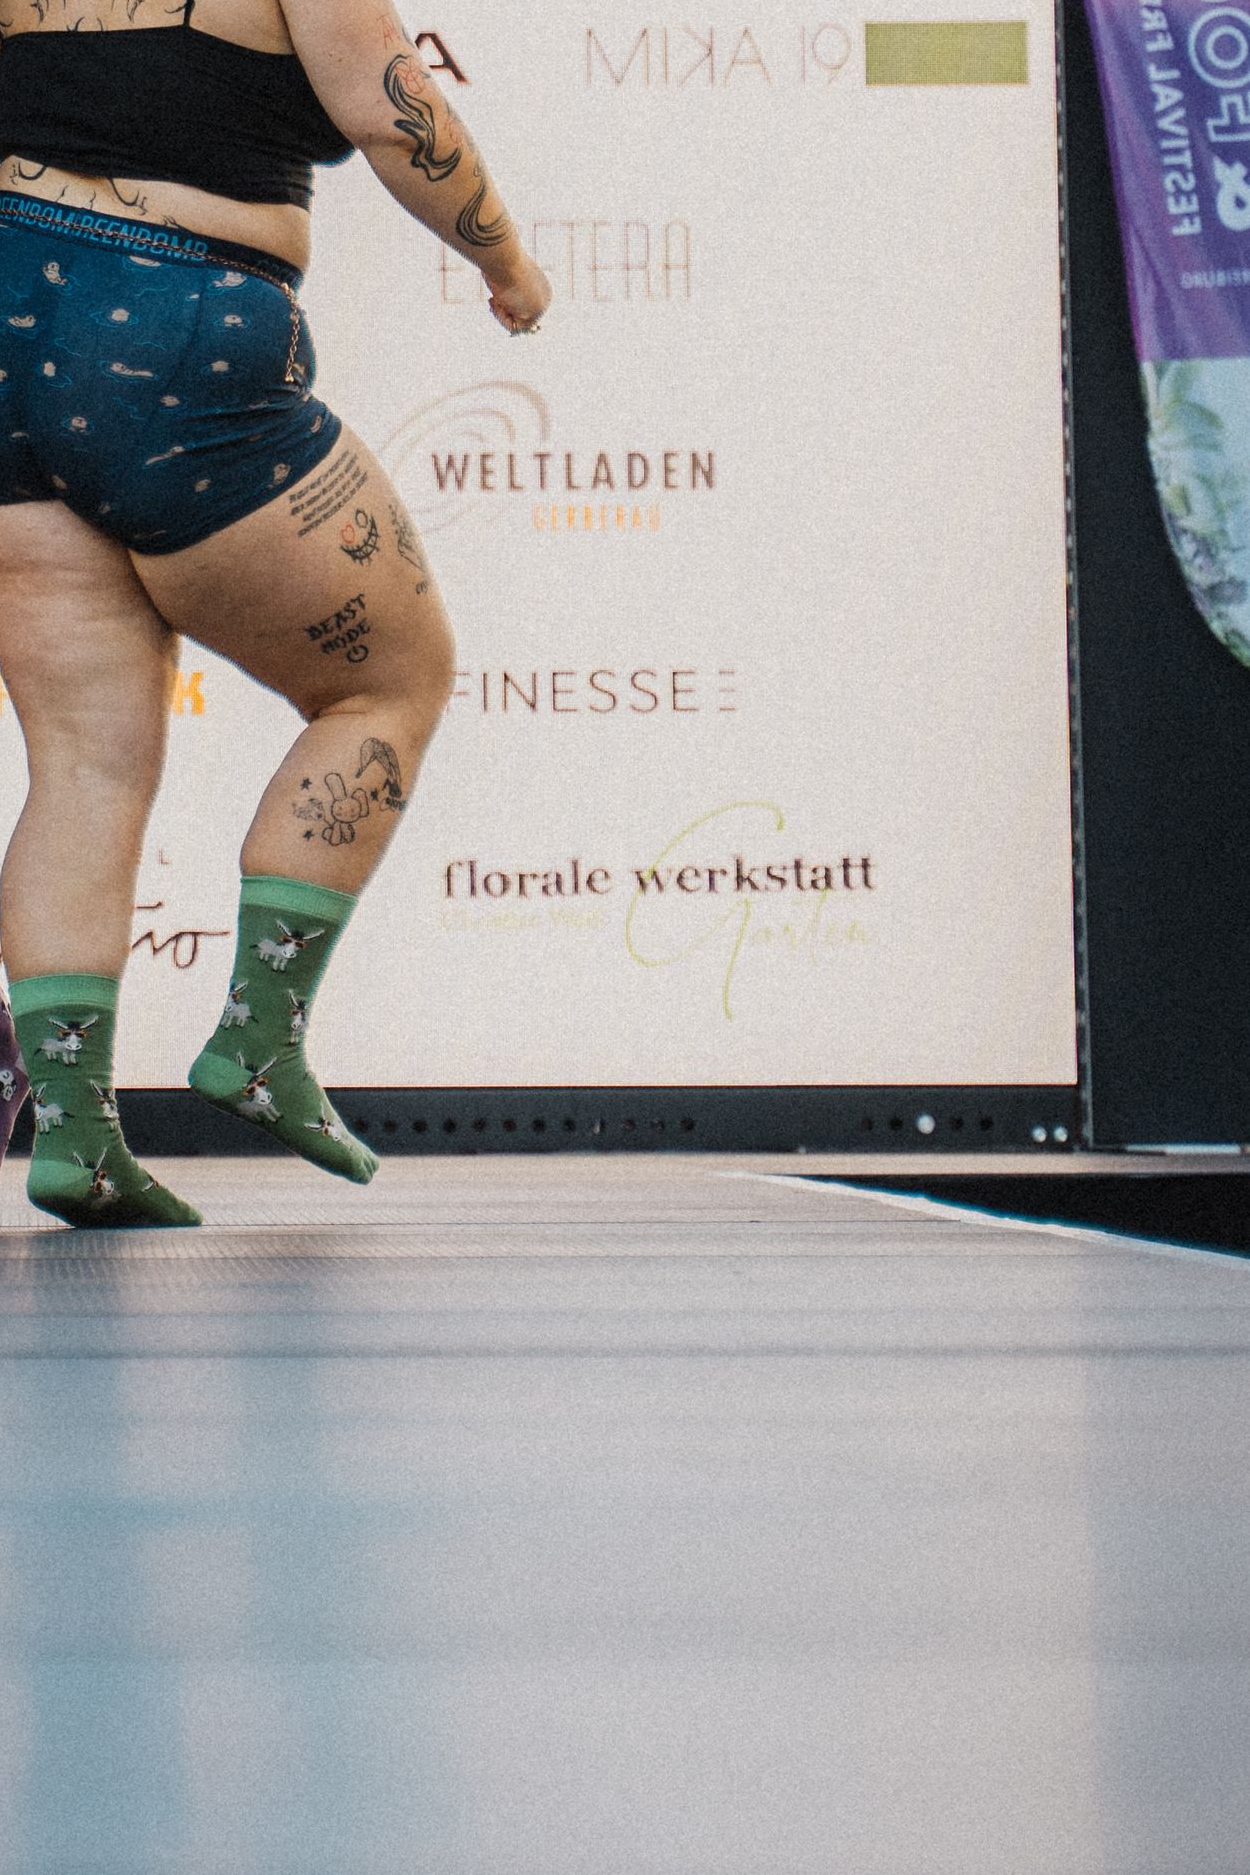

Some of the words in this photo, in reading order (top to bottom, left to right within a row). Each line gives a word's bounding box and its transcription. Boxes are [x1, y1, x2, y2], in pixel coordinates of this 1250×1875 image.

[586, 27, 772, 87] MIKA
[431, 451, 716, 492] WELTLADEN
[305, 592, 366, 642] BEAST
[321, 617, 371, 655] MODE
[444, 856, 612, 899] florale
[634, 855, 876, 895] werkstatt
